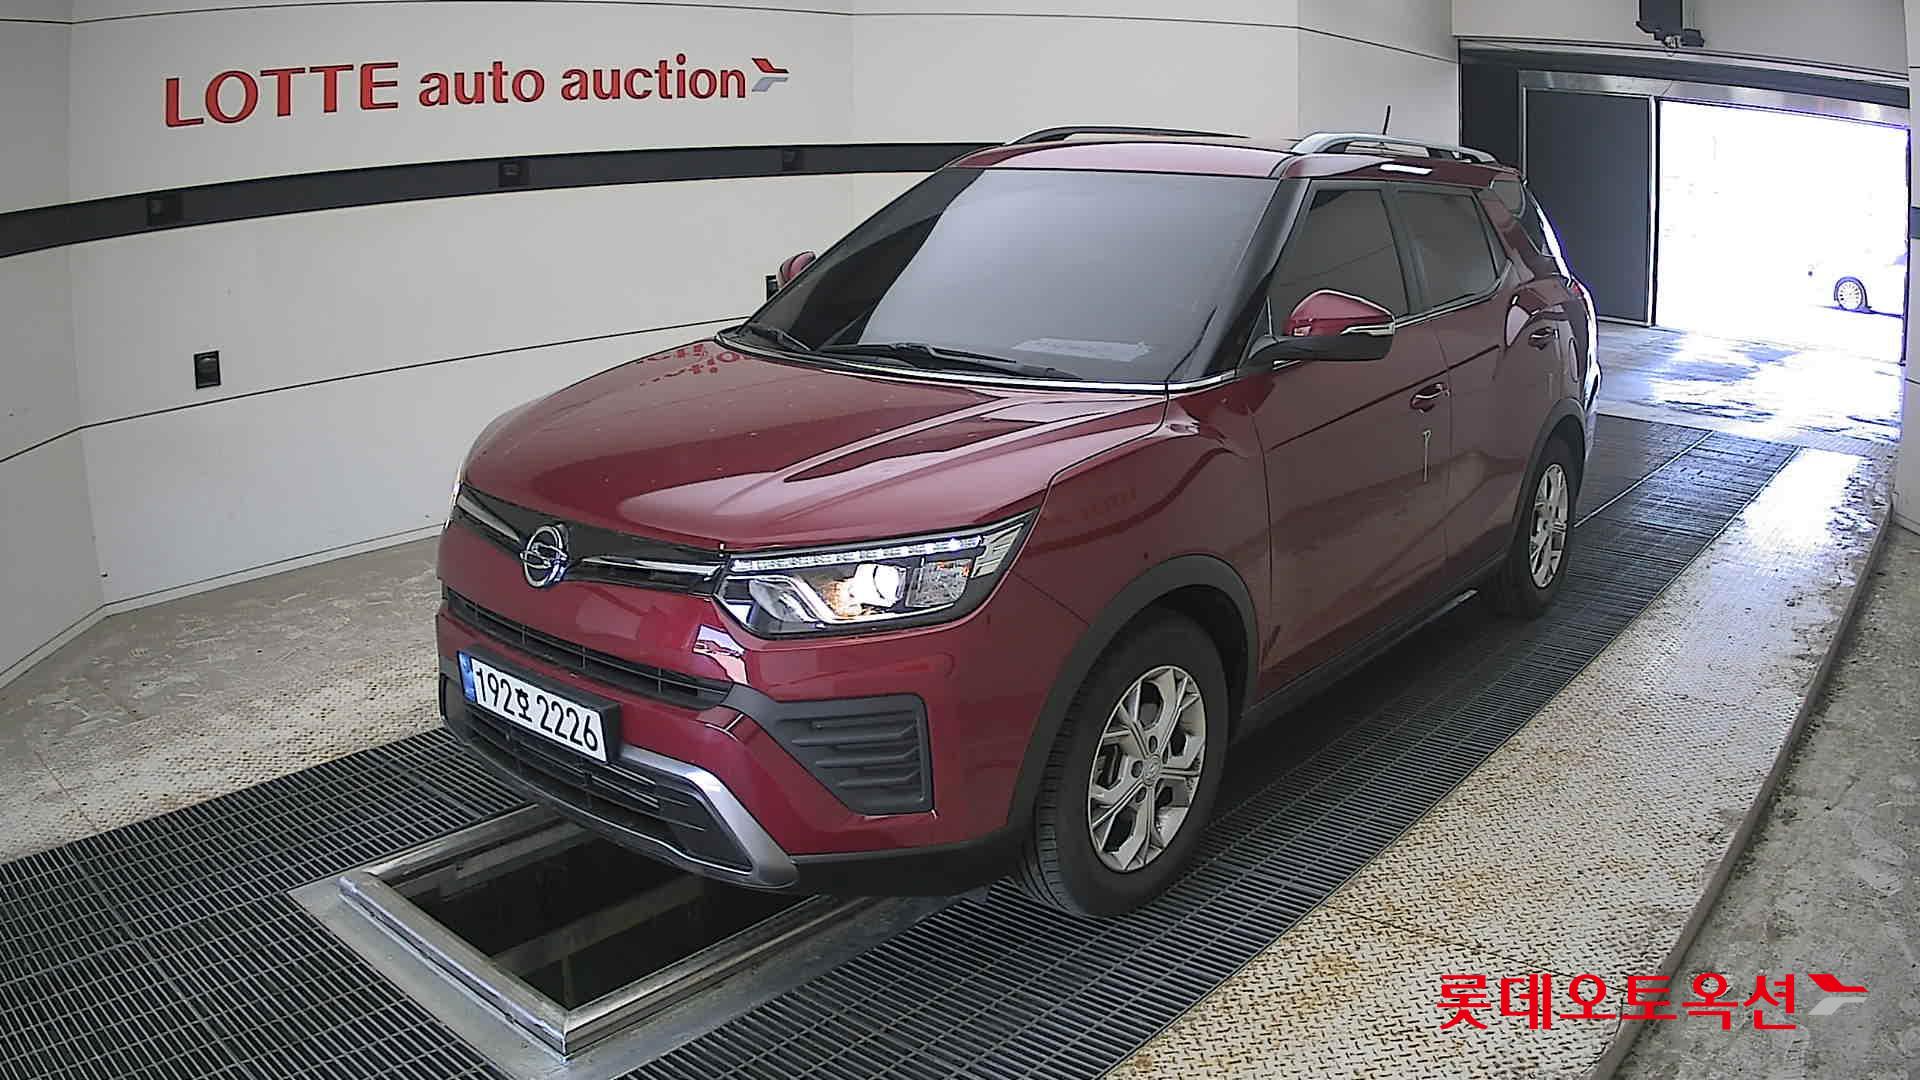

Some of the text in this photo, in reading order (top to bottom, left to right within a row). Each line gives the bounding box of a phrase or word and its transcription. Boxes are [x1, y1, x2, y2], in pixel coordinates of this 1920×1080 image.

[165, 53, 747, 127] LOTTE auto auction
[536, 694, 599, 752] 2226
